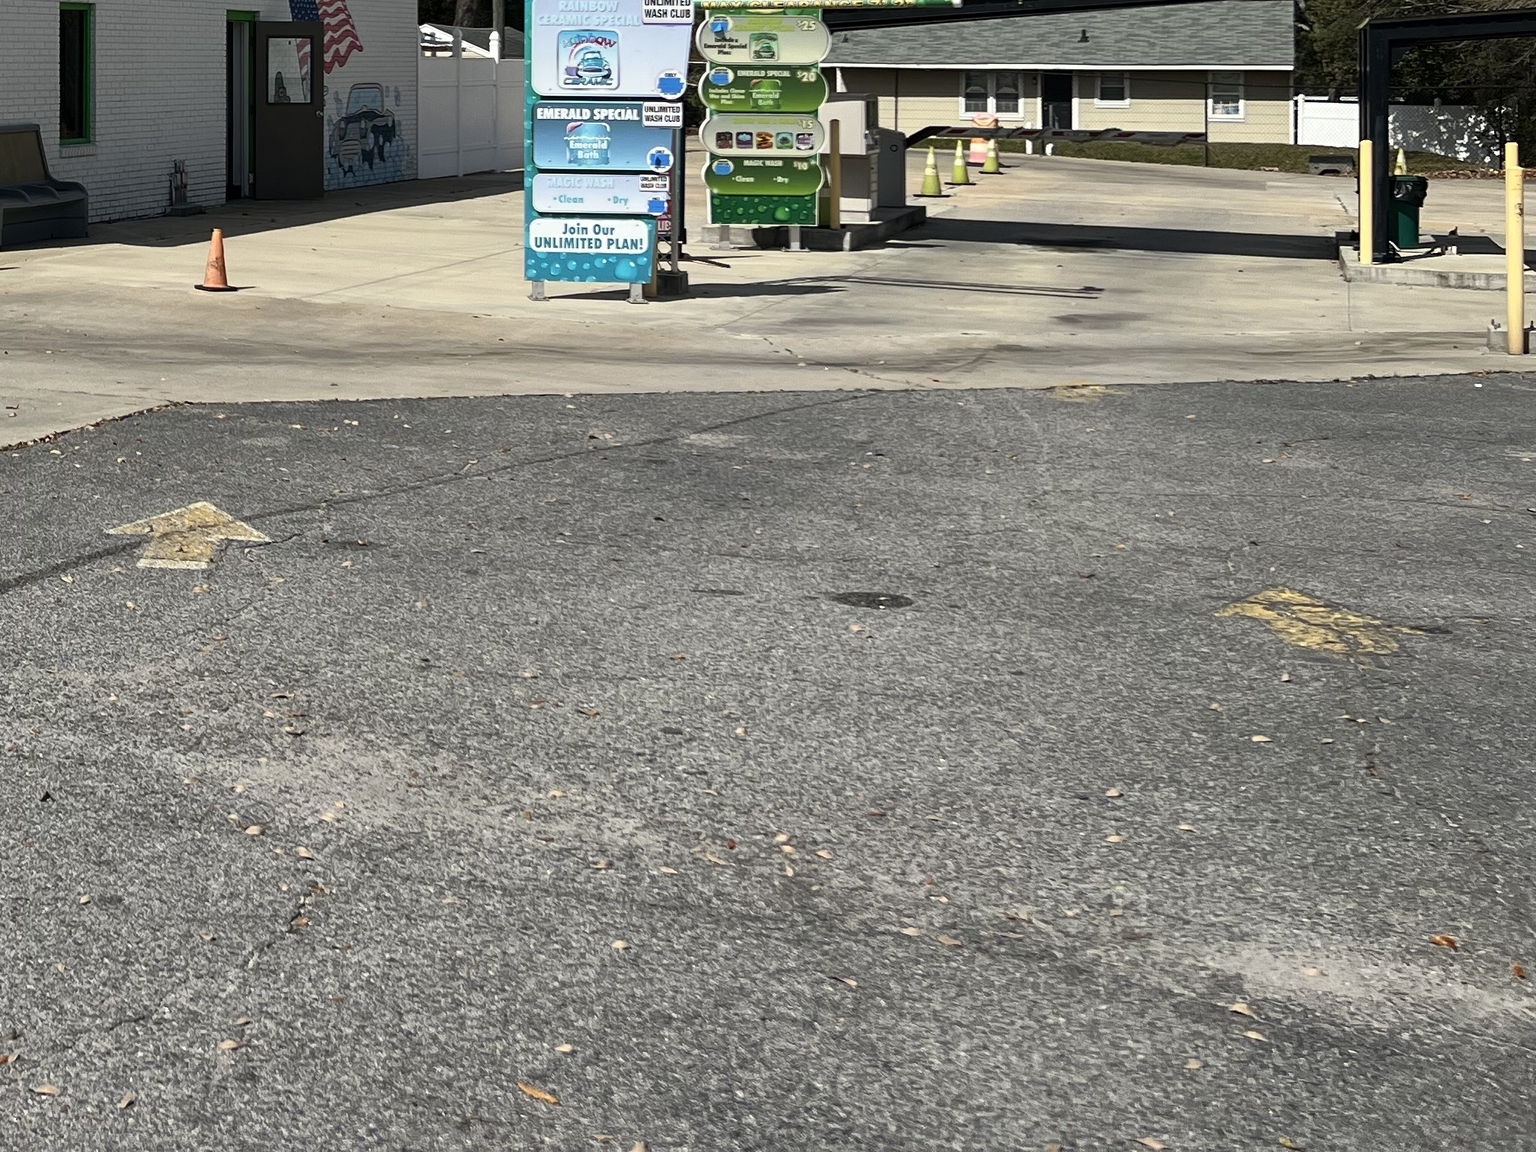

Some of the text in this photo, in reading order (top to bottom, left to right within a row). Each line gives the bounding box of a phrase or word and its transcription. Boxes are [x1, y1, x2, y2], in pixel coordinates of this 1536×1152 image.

[559, 0, 619, 13] RAINBOW
[749, 0, 864, 9] CLEARANCE
[644, 9, 691, 19] WASH CLUB
[538, 13, 641, 27] CERAMIC SPECIAL
[797, 20, 816, 31] $25
[796, 70, 817, 82] $20
[564, 77, 613, 86] CERAMIC
[536, 106, 641, 121] EMERALD SPECIAL
[644, 105, 681, 114] UNLIMITED
[644, 114, 681, 123] WASH CLUB
[798, 119, 813, 129] $15
[570, 140, 608, 150] Emerald
[577, 150, 599, 159] Bath
[547, 177, 614, 189] MAGIC WASH
[558, 194, 584, 204] Clean
[613, 195, 629, 206] Dry
[562, 223, 616, 235] Join Our
[534, 236, 644, 250] UNLIMITED PLAN!
